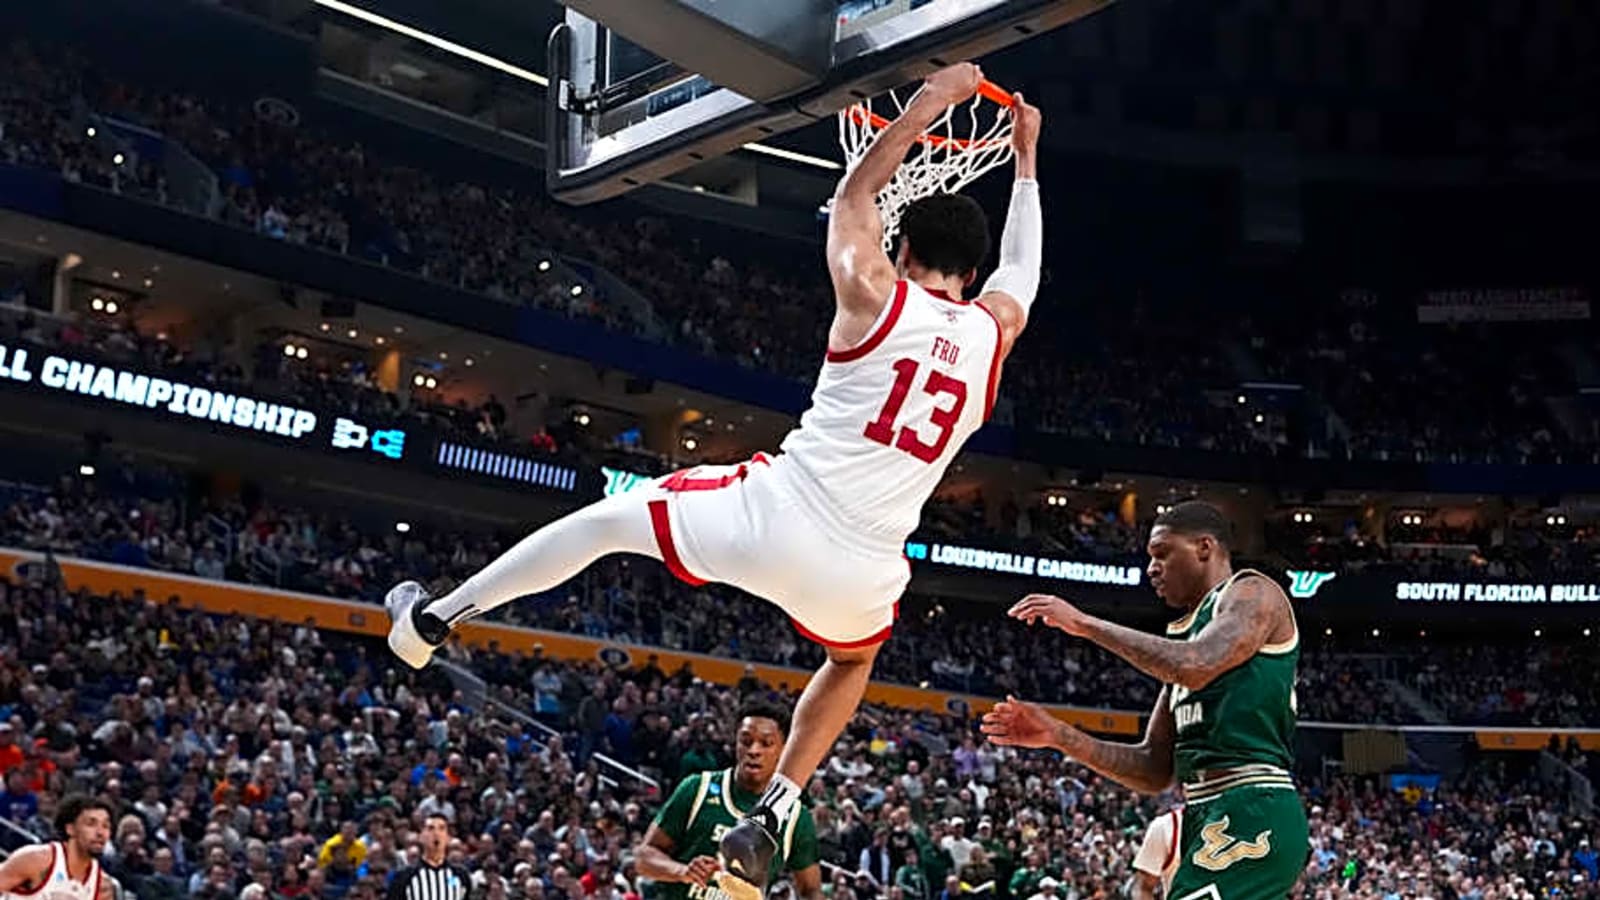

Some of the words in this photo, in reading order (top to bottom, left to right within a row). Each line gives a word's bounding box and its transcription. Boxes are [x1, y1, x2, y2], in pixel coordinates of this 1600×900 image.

[931, 336, 960, 366] FRU
[41, 355, 317, 438] CHAMPIONSHIP
[863, 357, 967, 464] 13
[906, 542, 928, 560] VS
[931, 543, 1035, 575] LOUISVILLE
[1036, 558, 1141, 586] CARDINALS
[1396, 582, 1460, 601] SOUTH
[1463, 583, 1547, 602] FLORIDA
[1550, 584, 1600, 602] BULL
